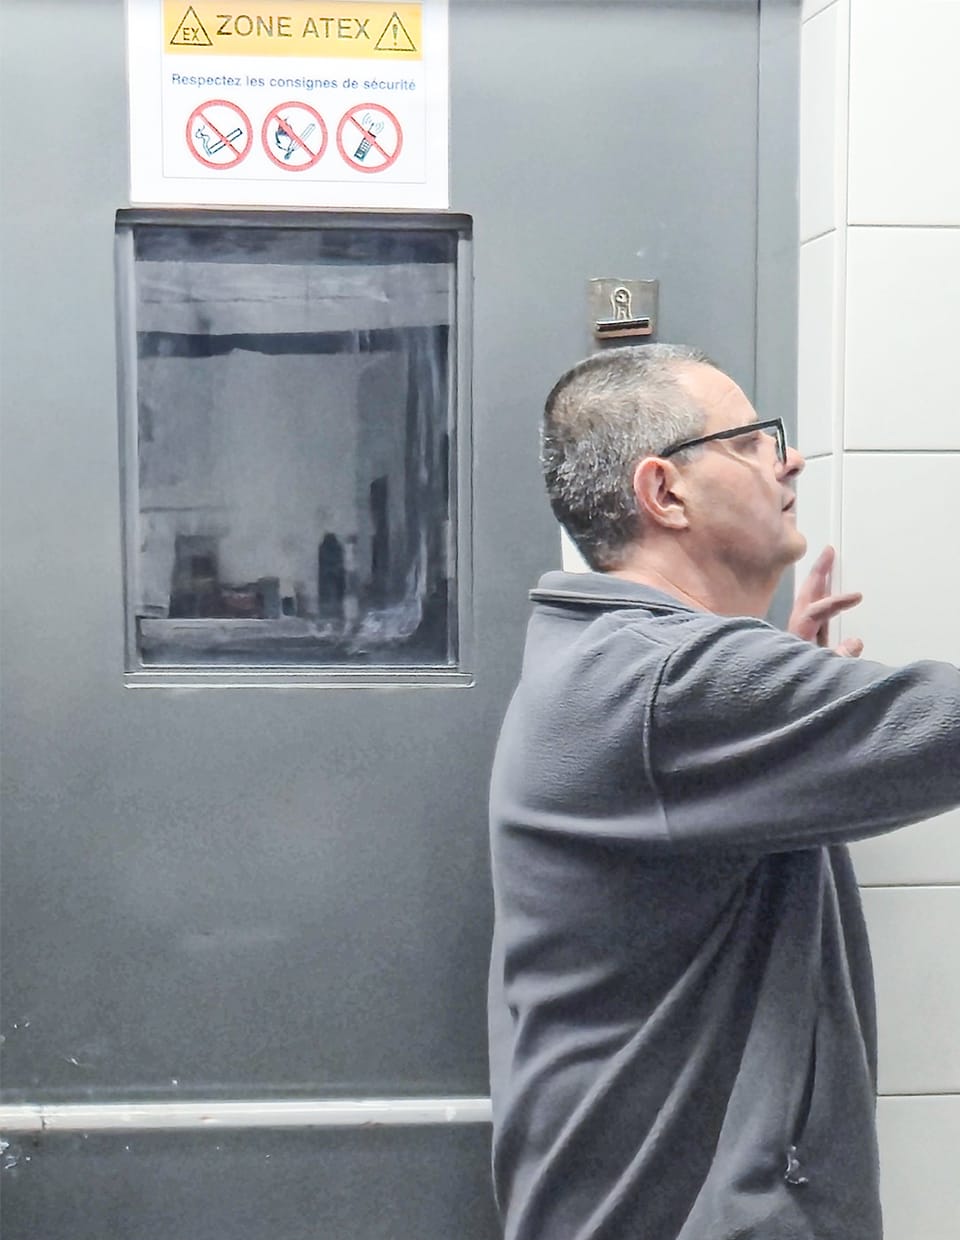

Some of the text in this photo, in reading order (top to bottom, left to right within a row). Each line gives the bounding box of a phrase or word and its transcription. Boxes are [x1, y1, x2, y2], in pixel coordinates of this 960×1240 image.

[182, 27, 200, 42] EX
[216, 14, 371, 40] ZONE ATEX
[172, 73, 416, 91] Respectez les consignes de sécurité
